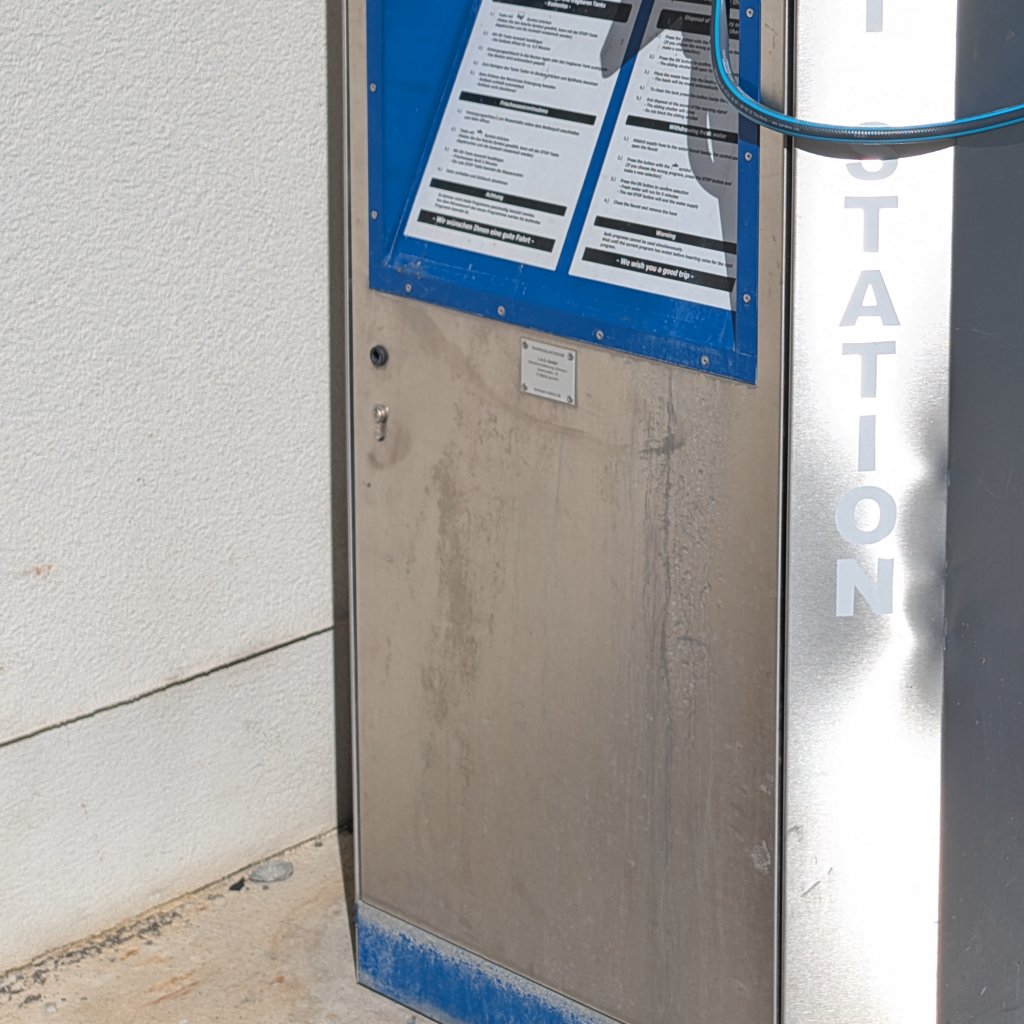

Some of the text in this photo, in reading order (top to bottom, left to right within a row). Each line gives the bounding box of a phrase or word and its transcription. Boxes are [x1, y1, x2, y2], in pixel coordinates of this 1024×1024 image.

[435, 216, 532, 244] Wir wünschen Ihnen eine gute Fahrt
[655, 230, 677, 240] Warning
[619, 258, 692, 280] We wish you a good trip
[835, 122, 900, 617] STATION
